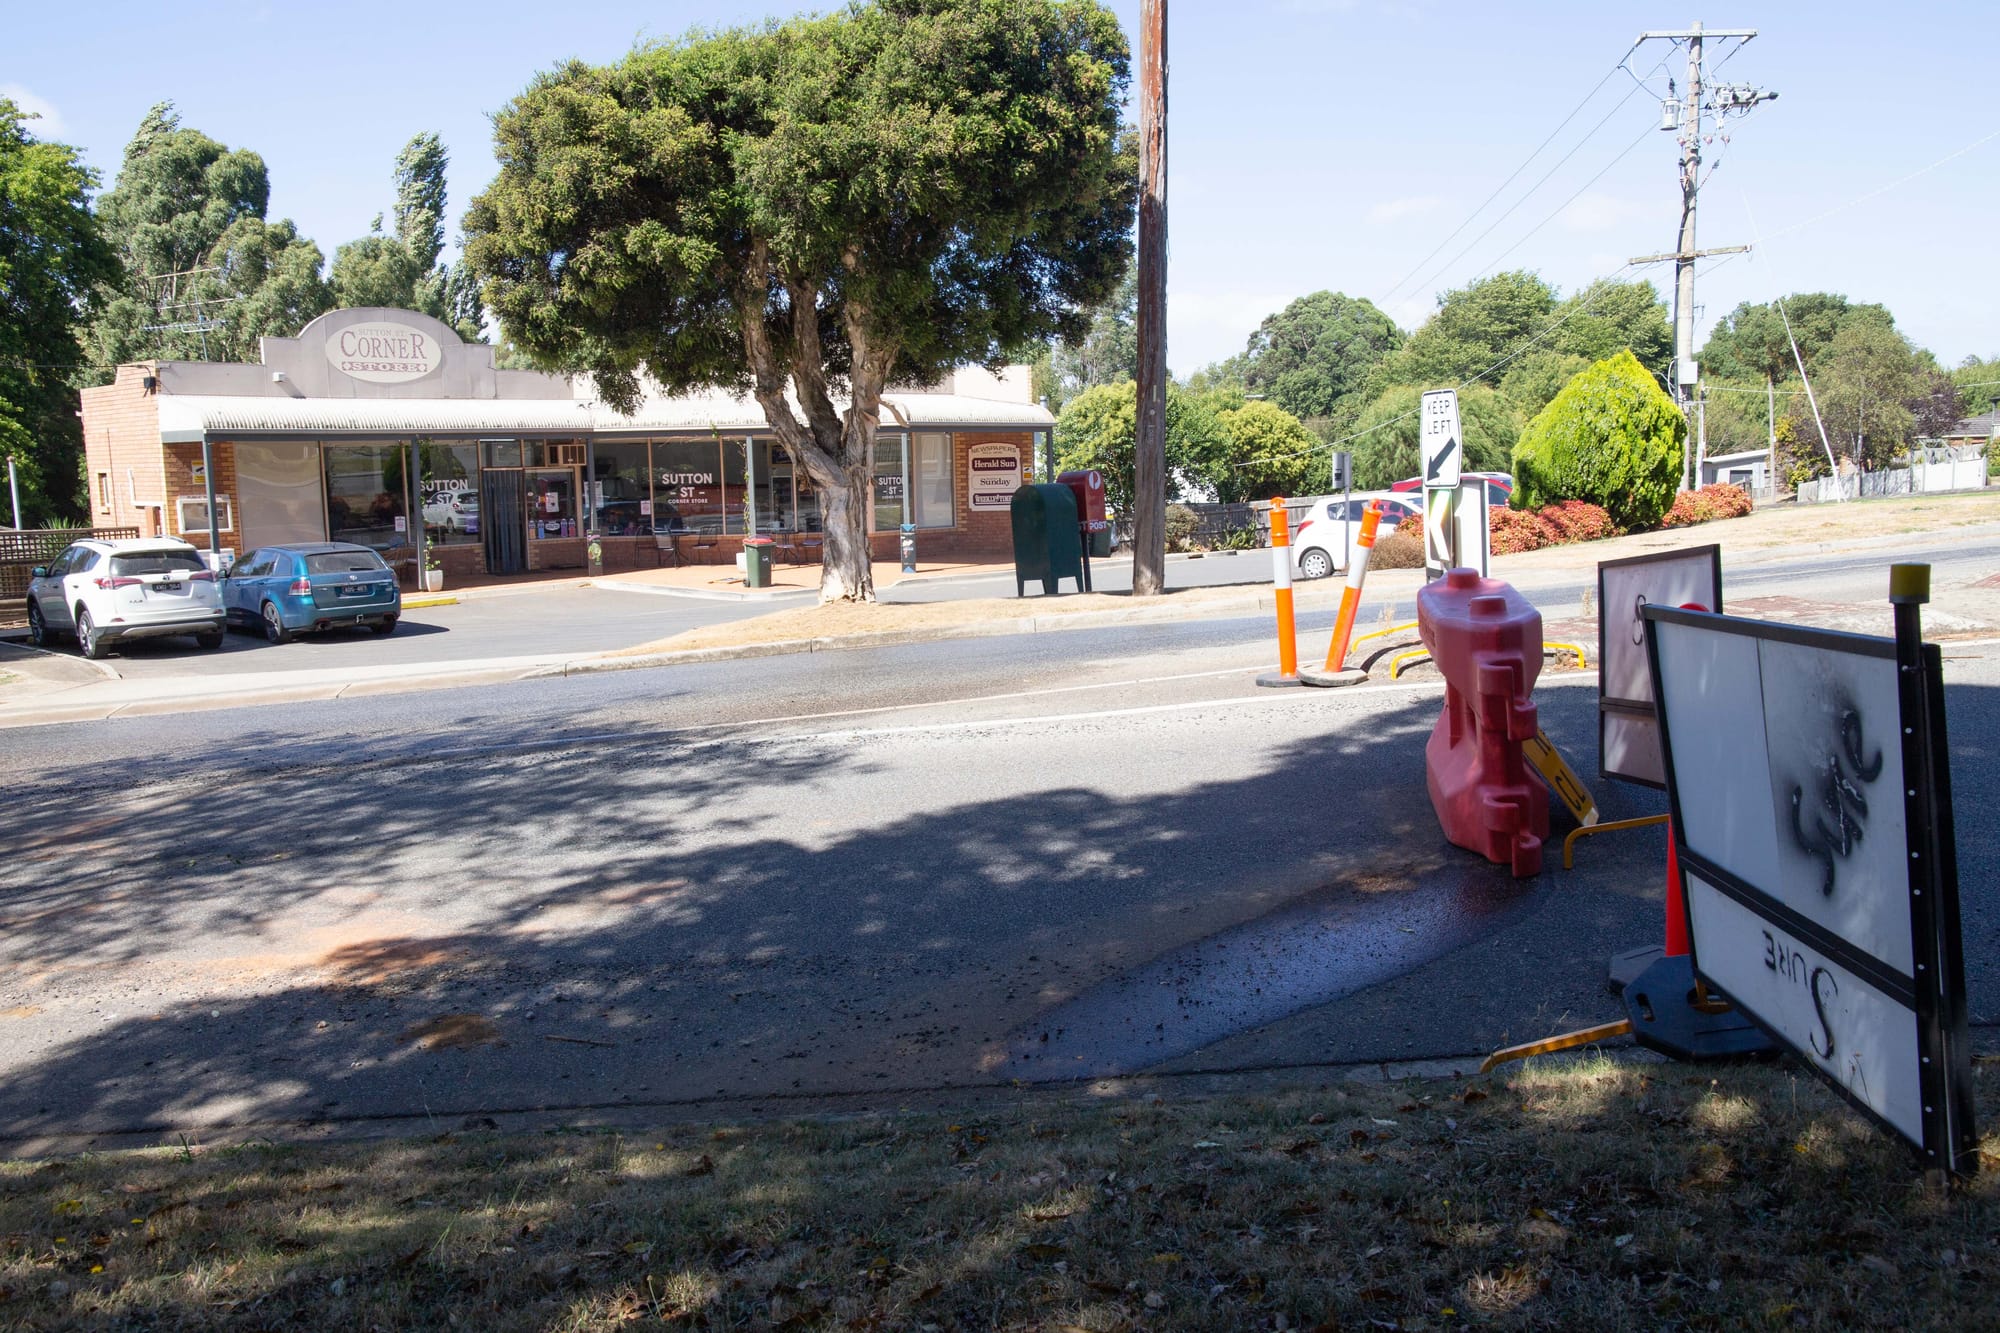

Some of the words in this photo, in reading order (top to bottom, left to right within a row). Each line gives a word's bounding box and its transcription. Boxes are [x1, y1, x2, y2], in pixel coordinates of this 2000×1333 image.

[340, 330, 427, 359] CORNER
[351, 362, 418, 372] STORE
[1427, 399, 1450, 415] KEEP
[1427, 419, 1451, 435] LEFT
[971, 445, 1017, 453] NEWSPAPERS
[974, 459, 999, 468] Herald
[1000, 459, 1015, 468] Sun
[419, 479, 468, 491] SUTTON
[662, 473, 713, 485] SUTTON
[980, 478, 1011, 486] Sunday
[680, 486, 695, 498] ST
[1089, 520, 1107, 530] POST
